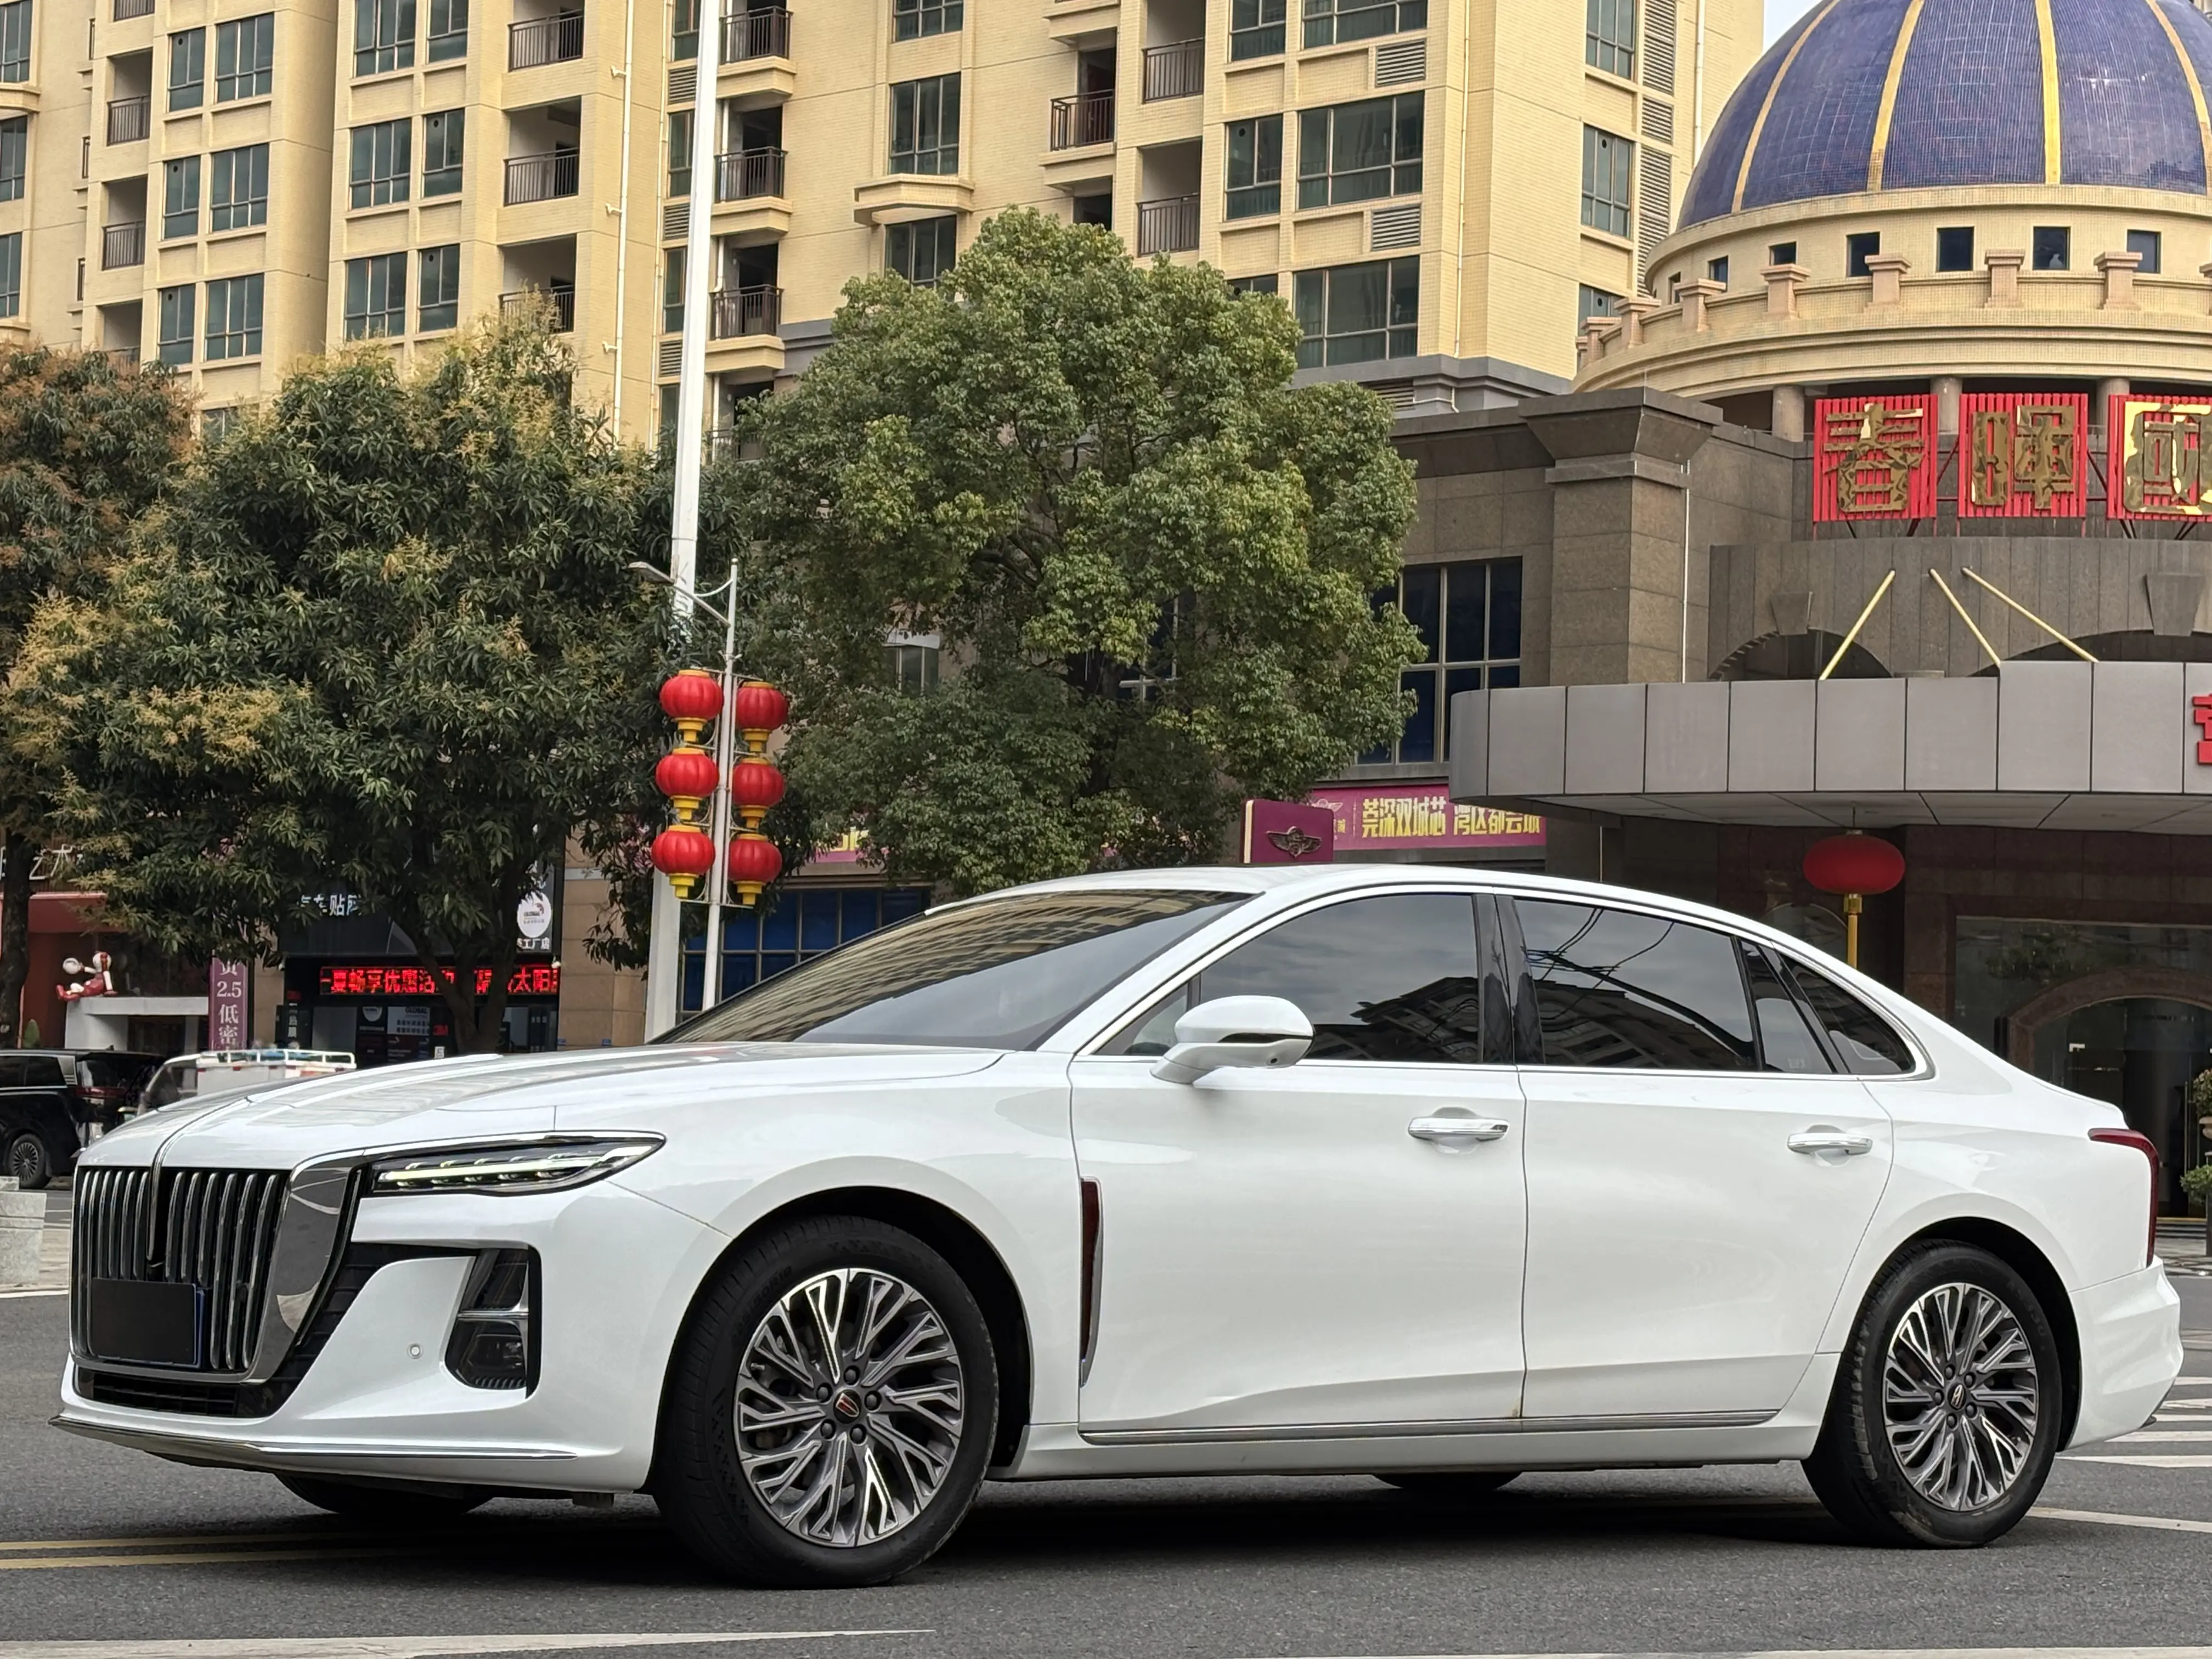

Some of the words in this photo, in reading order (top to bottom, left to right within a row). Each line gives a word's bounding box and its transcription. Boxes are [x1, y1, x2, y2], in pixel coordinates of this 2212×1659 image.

[1362, 796, 1446, 838] 莞深双城芯
